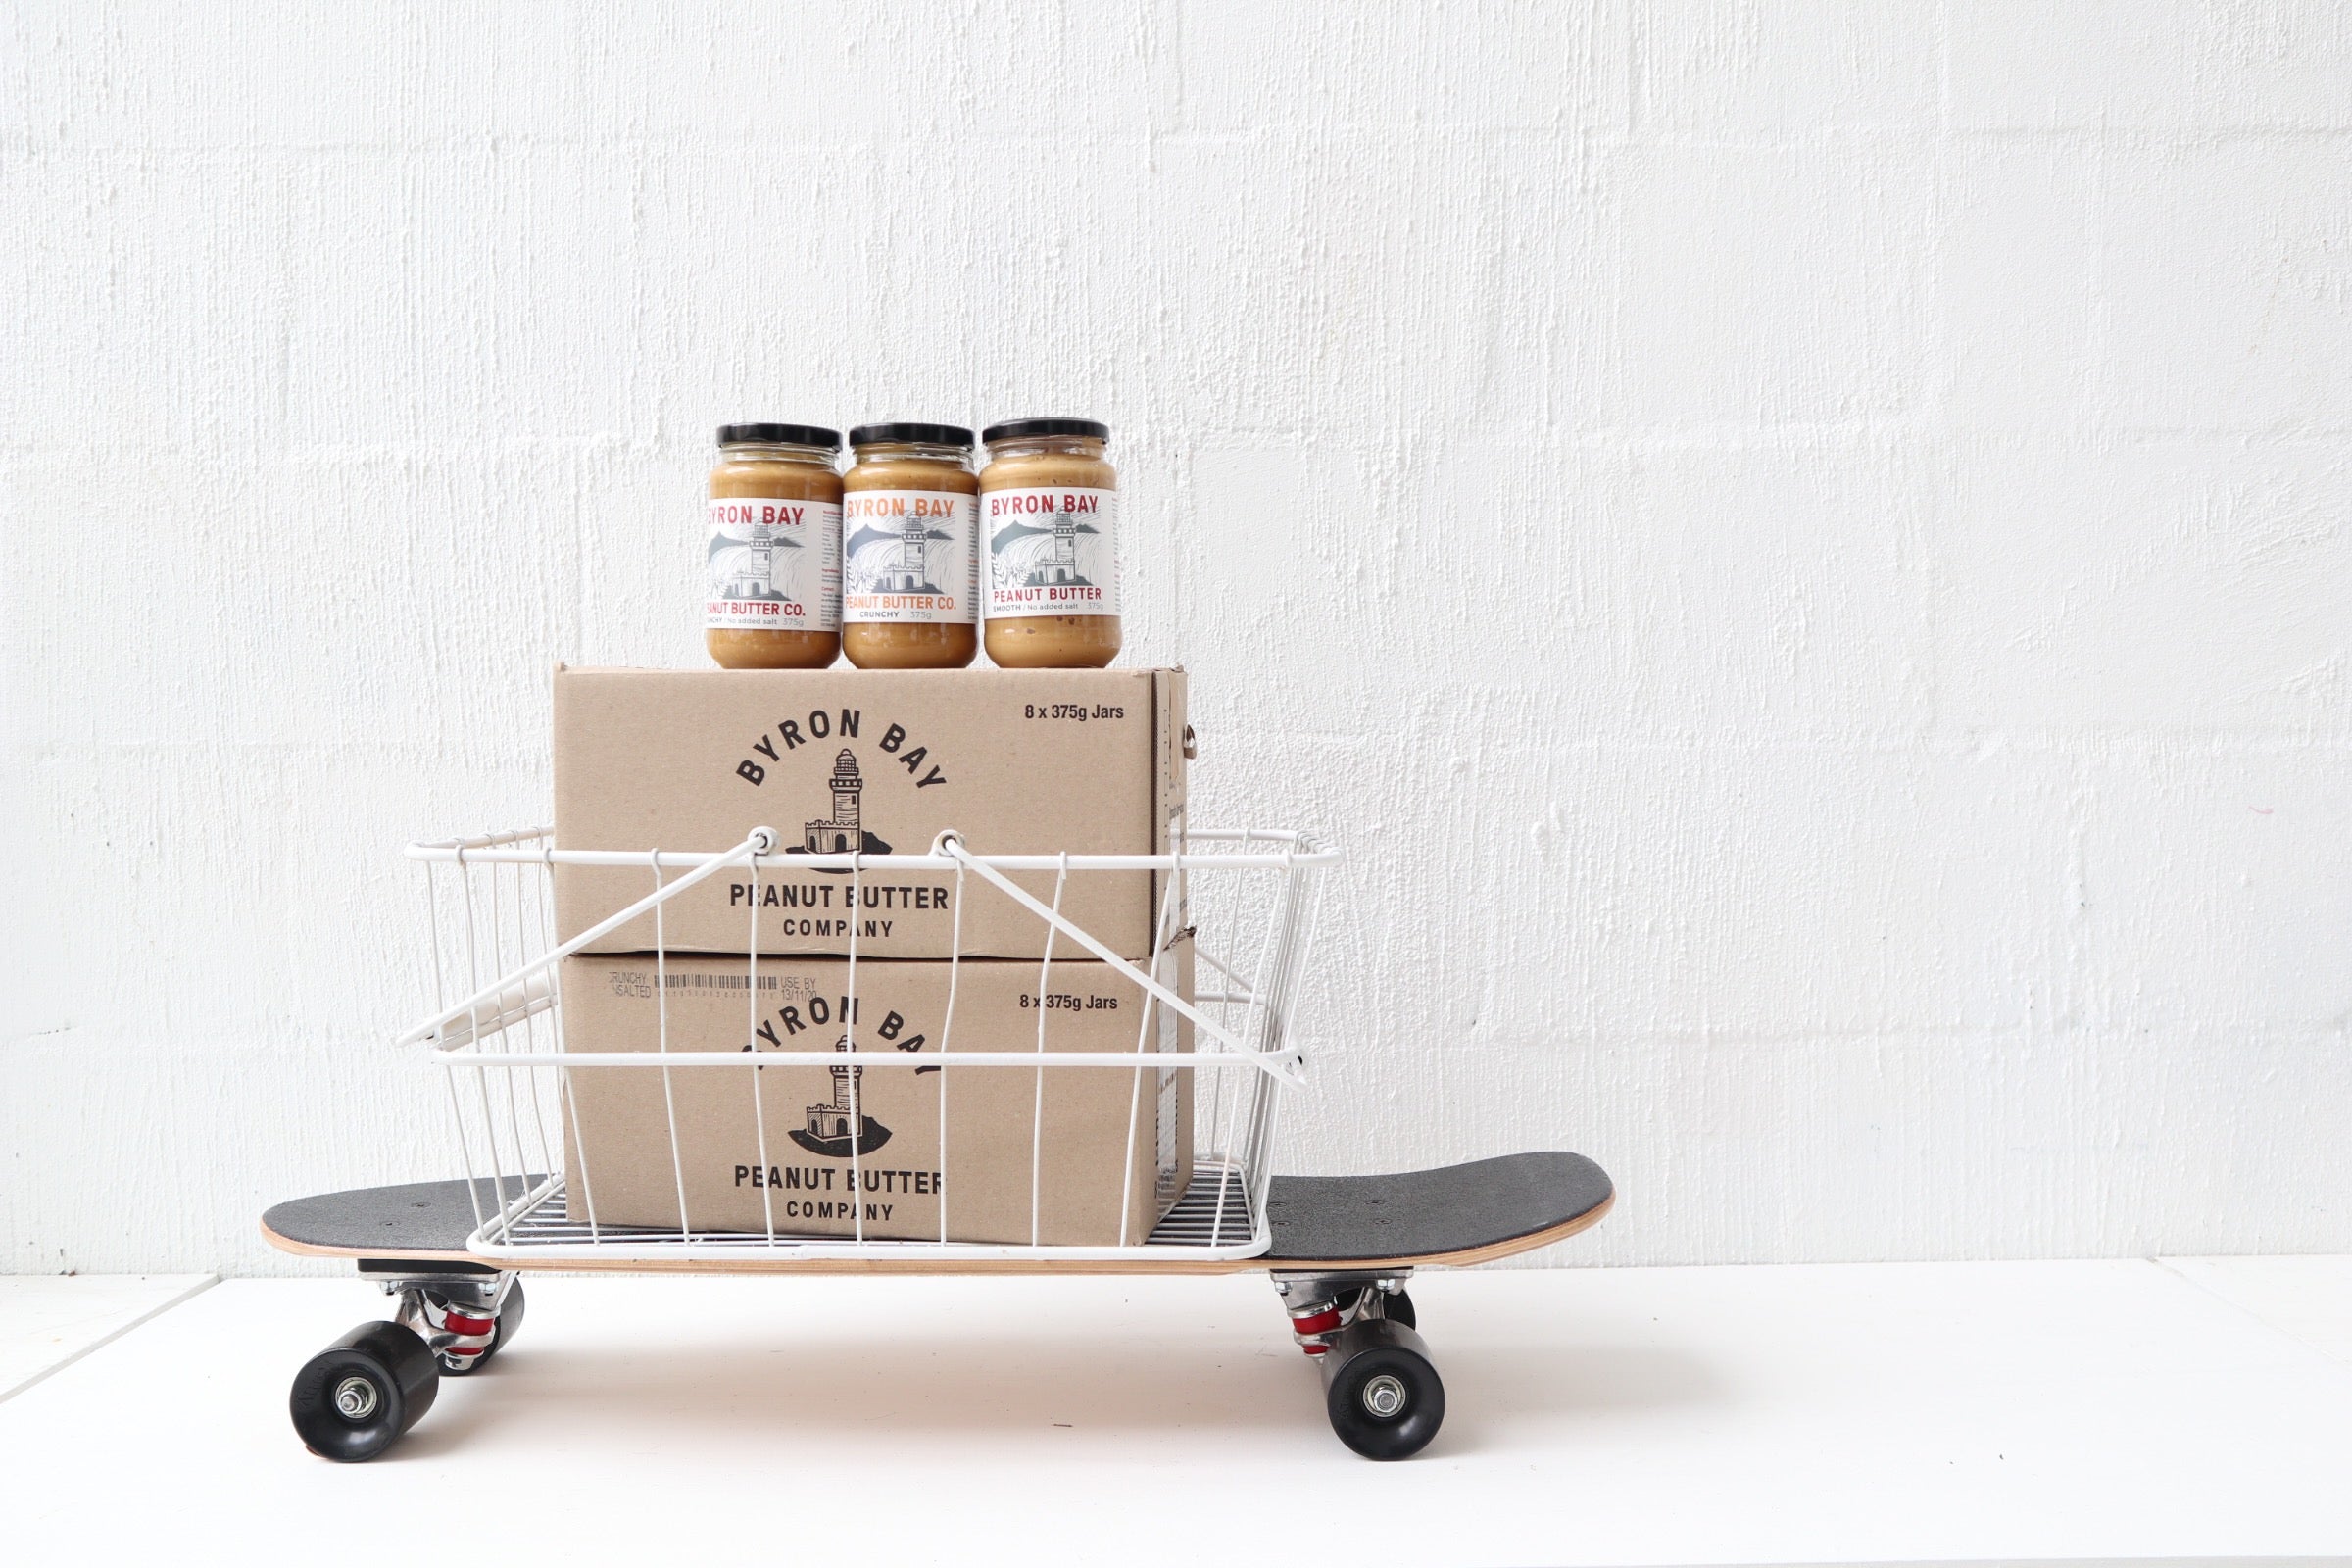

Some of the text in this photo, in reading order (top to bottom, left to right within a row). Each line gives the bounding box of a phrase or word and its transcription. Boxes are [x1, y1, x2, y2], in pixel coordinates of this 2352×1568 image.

[847, 498, 955, 517] BYRON BAY
[991, 495, 1099, 516] BYRON BAY
[762, 506, 804, 525] BAY
[846, 596, 956, 610] PEANUT BUTTER CO.
[994, 587, 1102, 603] PEANUT BUTTER
[706, 602, 806, 616] ANUT BUTTER CO.
[782, 617, 804, 627] 375g
[1025, 705, 1124, 721] 8 x 375g Jars
[736, 709, 947, 788] BYRON BAY
[730, 884, 949, 909] PEANUT BUTTER
[609, 972, 647, 984] RUNCHY
[781, 977, 816, 990] USE BY
[612, 984, 652, 998] SALTED
[1019, 994, 1117, 1011] 8 x 375g Jars
[742, 996, 858, 1070] YRON
[735, 1165, 835, 1190] PEANUT
